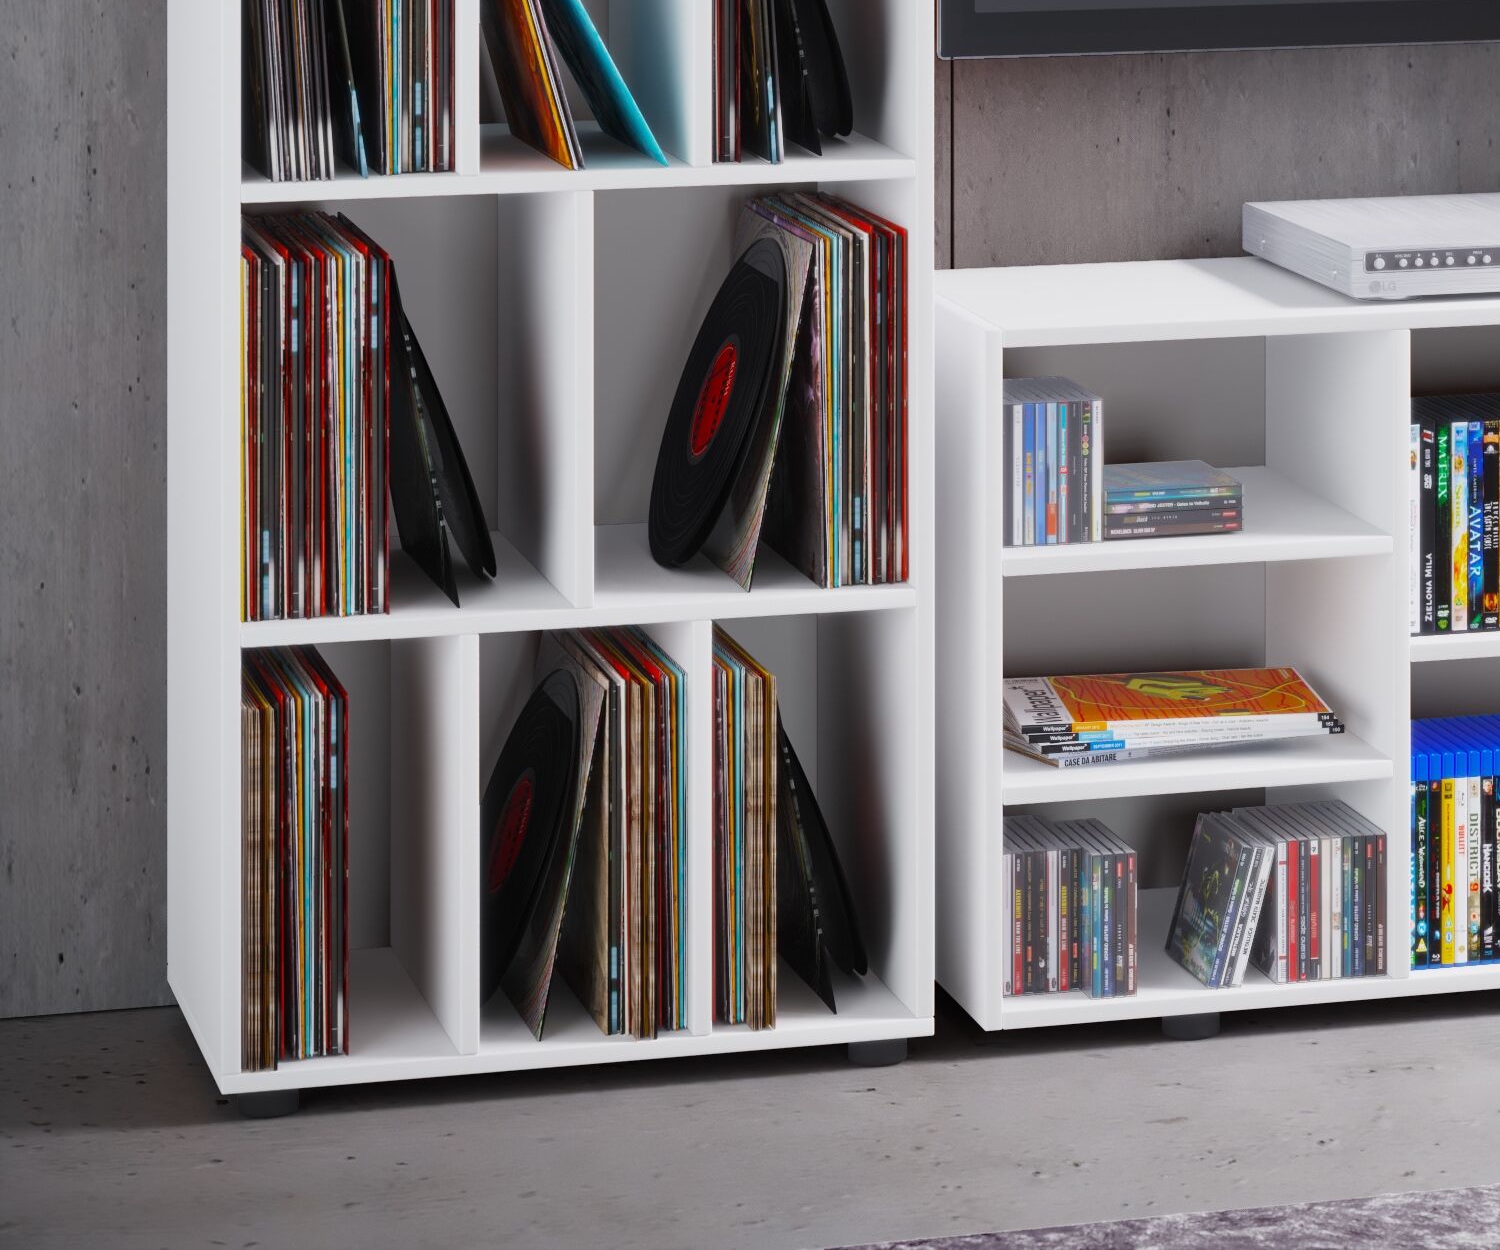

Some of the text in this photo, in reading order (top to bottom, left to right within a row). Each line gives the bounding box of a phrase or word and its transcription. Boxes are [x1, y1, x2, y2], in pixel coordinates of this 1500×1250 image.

[1438, 436, 1448, 500] MATRIX
[1468, 506, 1482, 578] AVATAR
[1425, 553, 1433, 622] ZIELONA MILA
[1064, 753, 1117, 767] CASE DA ABITARE
[1470, 813, 1479, 892] DISTRICT 9
[1483, 844, 1493, 893] HANCOCK
